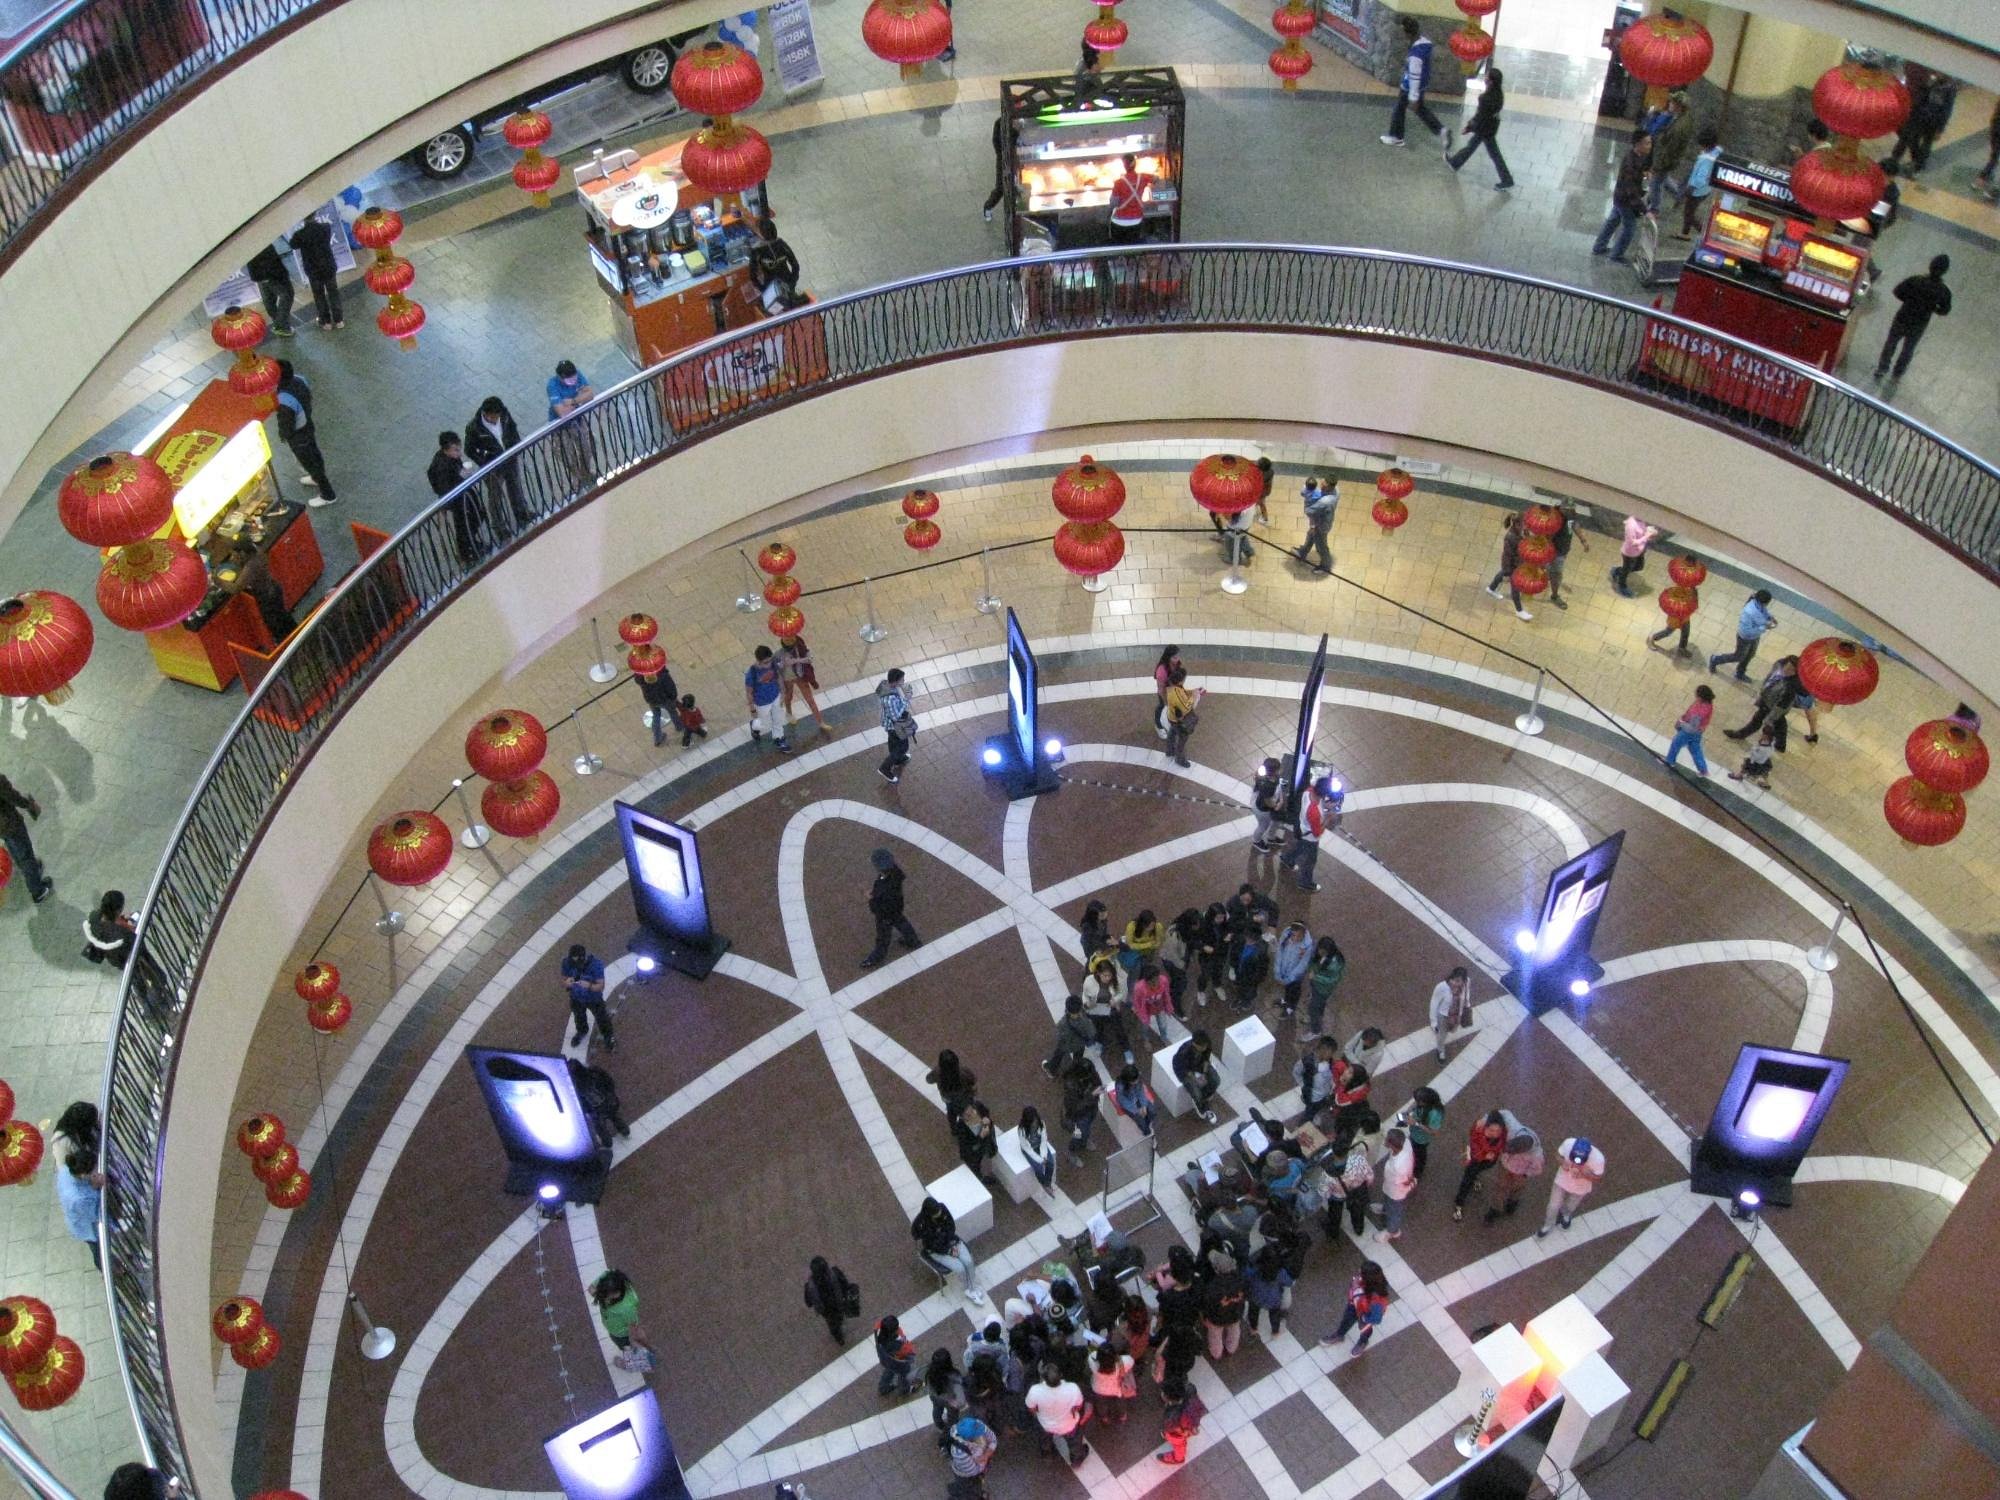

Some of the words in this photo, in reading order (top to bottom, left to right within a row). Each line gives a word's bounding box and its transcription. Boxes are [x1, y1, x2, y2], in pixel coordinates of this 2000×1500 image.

[1716, 166, 1762, 192] KRISPY
[1760, 182, 1797, 201] KRUS
[1748, 162, 1791, 181] KRISPY
[1651, 323, 1728, 363] KRISPY
[1731, 352, 1806, 391] KRUST
